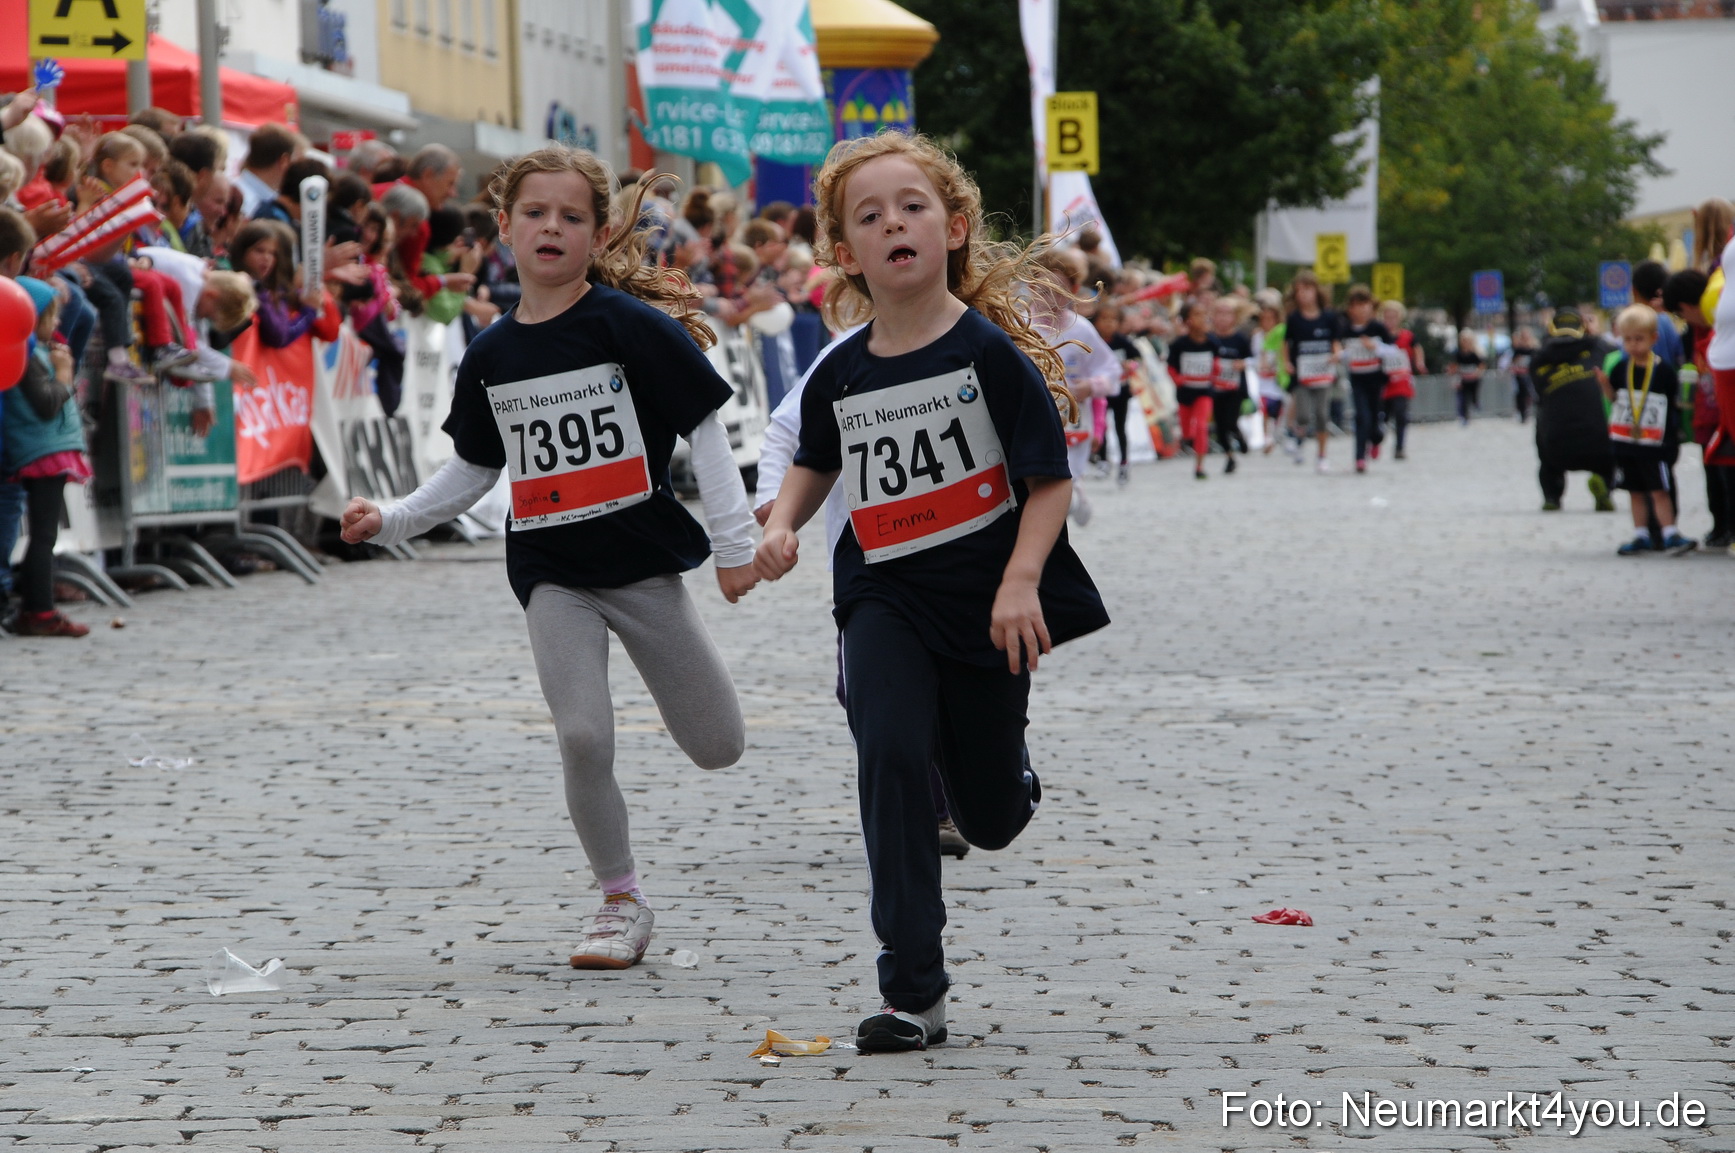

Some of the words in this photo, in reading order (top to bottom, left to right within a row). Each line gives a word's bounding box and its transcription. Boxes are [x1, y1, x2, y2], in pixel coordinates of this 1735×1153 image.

[1059, 118, 1083, 154] B
[493, 397, 528, 415] PARTL
[529, 383, 605, 409] Neumarkt
[840, 412, 873, 433] ARTL
[875, 394, 952, 425] Neumarkt
[510, 405, 625, 475] 7395
[848, 417, 976, 503] 7341
[519, 490, 548, 512] Sophia
[876, 507, 938, 537] Emma
